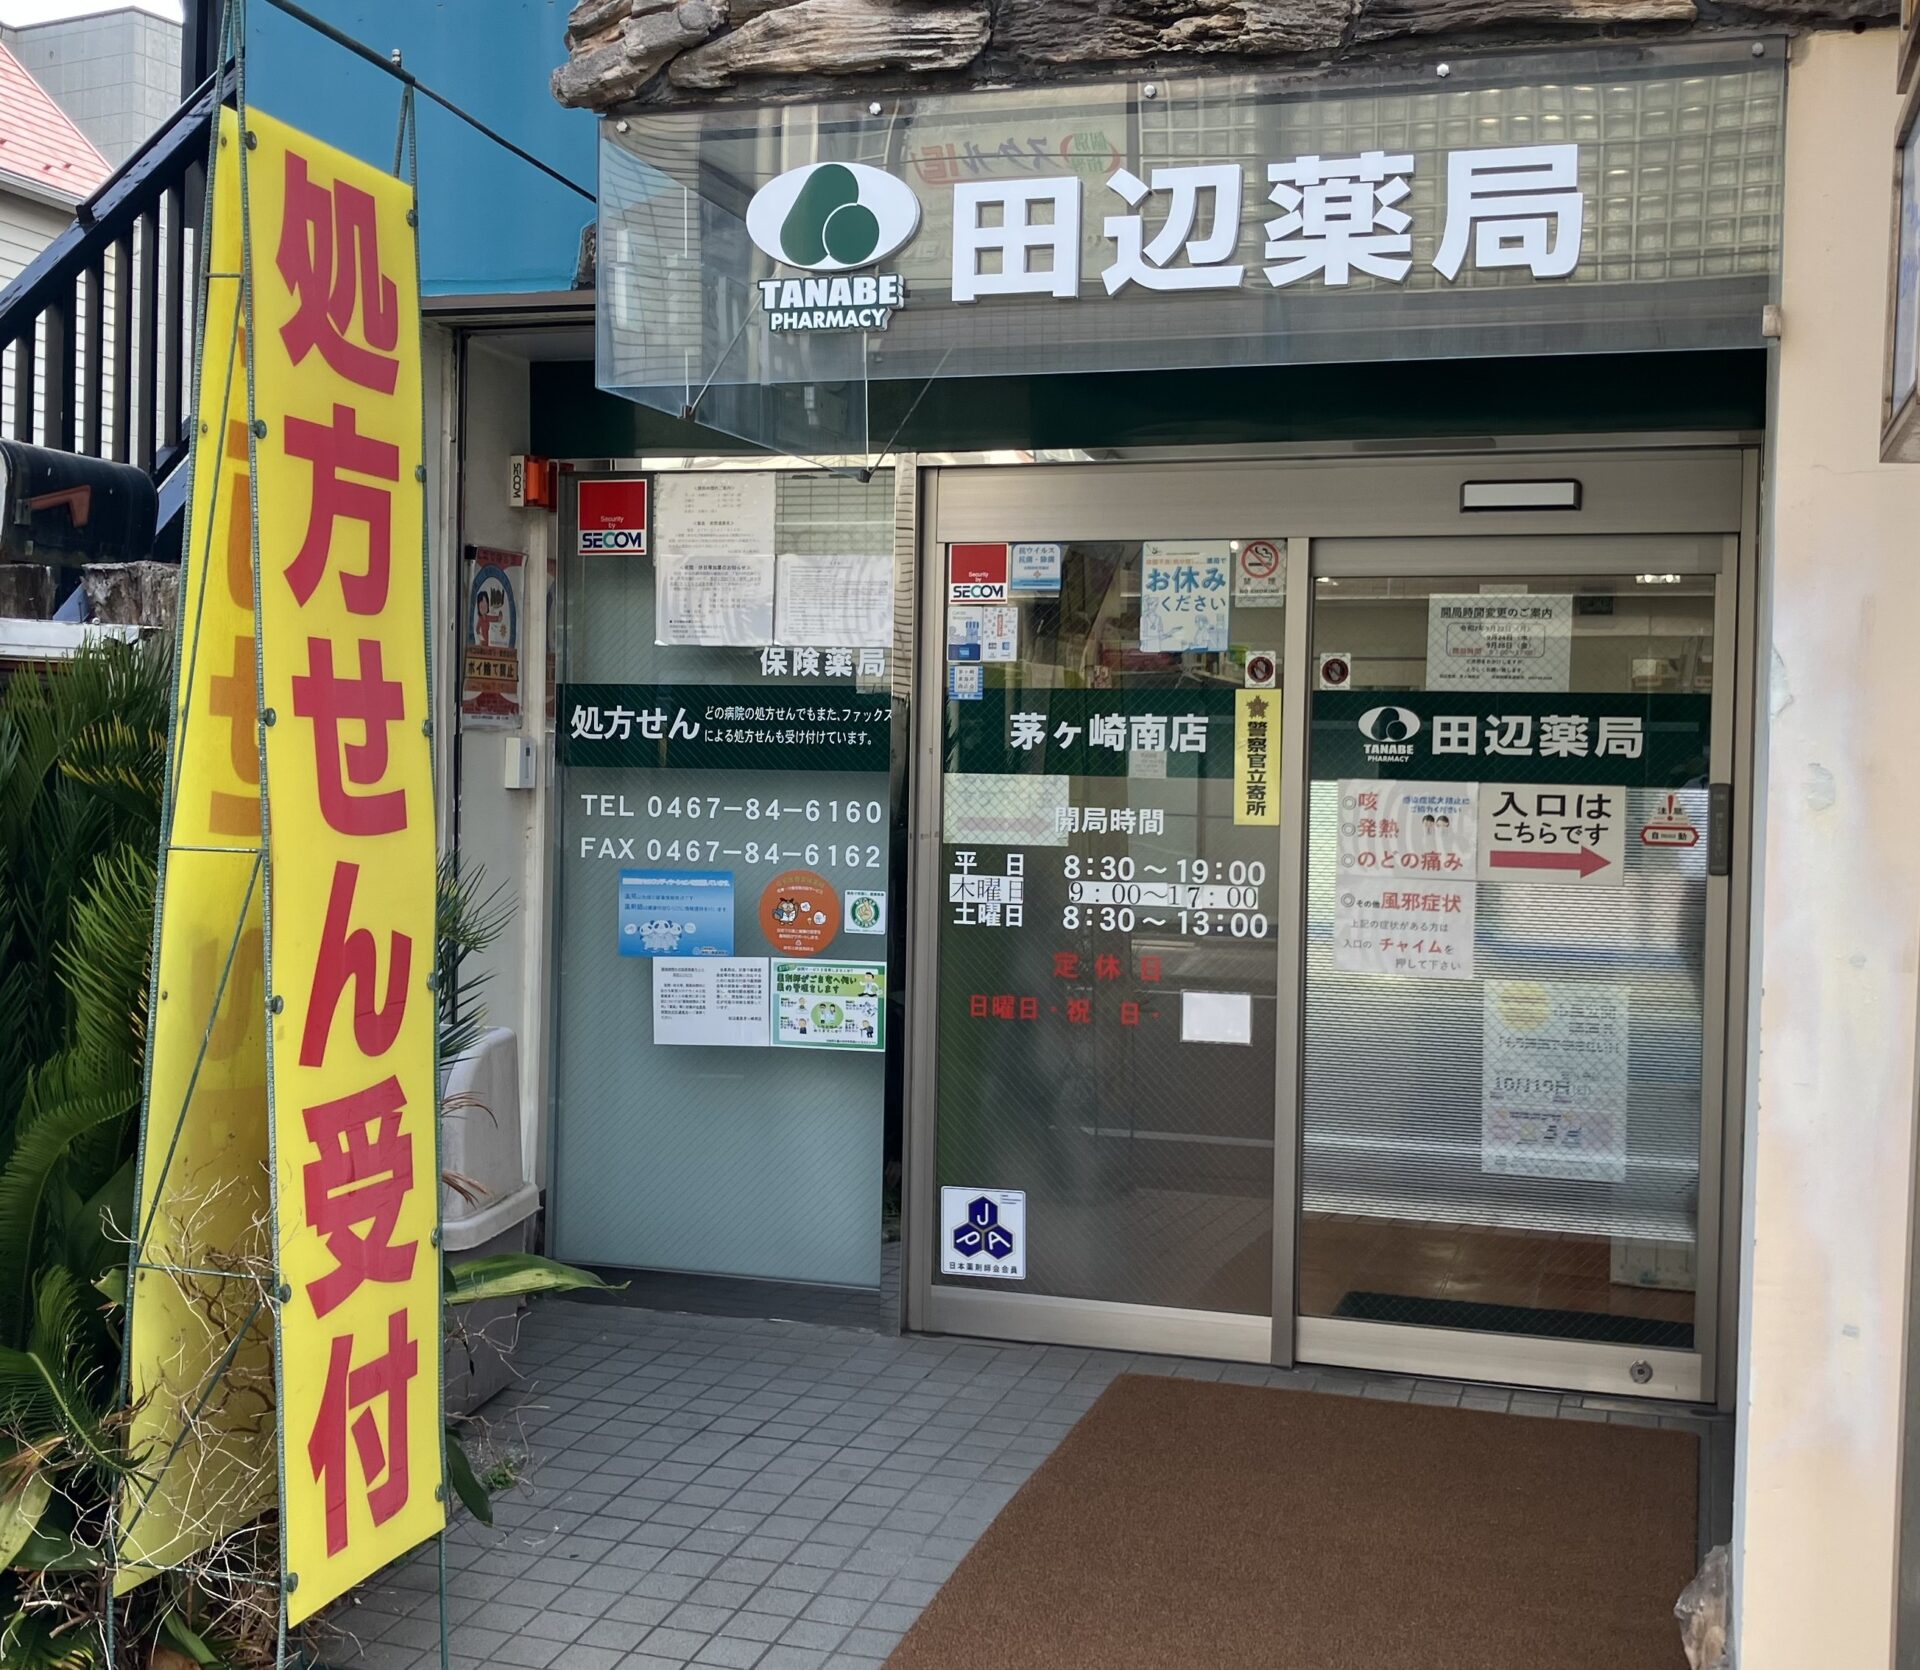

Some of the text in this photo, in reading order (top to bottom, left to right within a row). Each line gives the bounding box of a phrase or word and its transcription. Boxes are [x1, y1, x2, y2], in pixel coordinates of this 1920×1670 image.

[952, 143, 1584, 303] 田辺薬局
[759, 275, 898, 309] TANABE
[770, 308, 886, 330] PHARMACY
[513, 463, 521, 498] SECOM
[582, 532, 642, 548] SECOM
[968, 571, 989, 579] Security
[1146, 566, 1226, 593] お休み
[953, 585, 1004, 598] SECOM
[1161, 595, 1226, 612] ください
[1440, 607, 1553, 619] 開局時間変更のご案内
[760, 647, 886, 677] 保険薬局
[570, 705, 893, 741] 処方せん どの病院の処方せんでもまた、ファックス
[1010, 713, 1210, 753] 茅ヶ崎南店
[704, 730, 873, 746] による処方せんも受け付けています。
[1363, 743, 1415, 755] TANABE
[1432, 714, 1645, 760] 田辺薬局
[1246, 721, 1268, 817] 警察官立寄所
[1367, 755, 1410, 763] PHARMACY
[580, 794, 882, 824] TEL 0467-84-6160
[1358, 791, 1379, 811] 咳
[1491, 791, 1613, 820] 入口は
[1054, 807, 1165, 836] 開局時間
[1357, 818, 1400, 839] 発熱
[1493, 821, 1610, 846] こちらです
[275, 150, 419, 1558] 処方せん受付
[580, 837, 881, 868] FAX 0467-84-6162
[1357, 850, 1464, 871] のどの痛み
[951, 877, 1025, 902] 木曜日
[953, 904, 1025, 928] 土曜日
[1350, 919, 1449, 933] 上記の症状がある方は
[1053, 953, 1162, 983] 定休日
[1395, 958, 1462, 971] 押して下さい
[949, 1262, 1018, 1274] 日本薬剤師会会員
